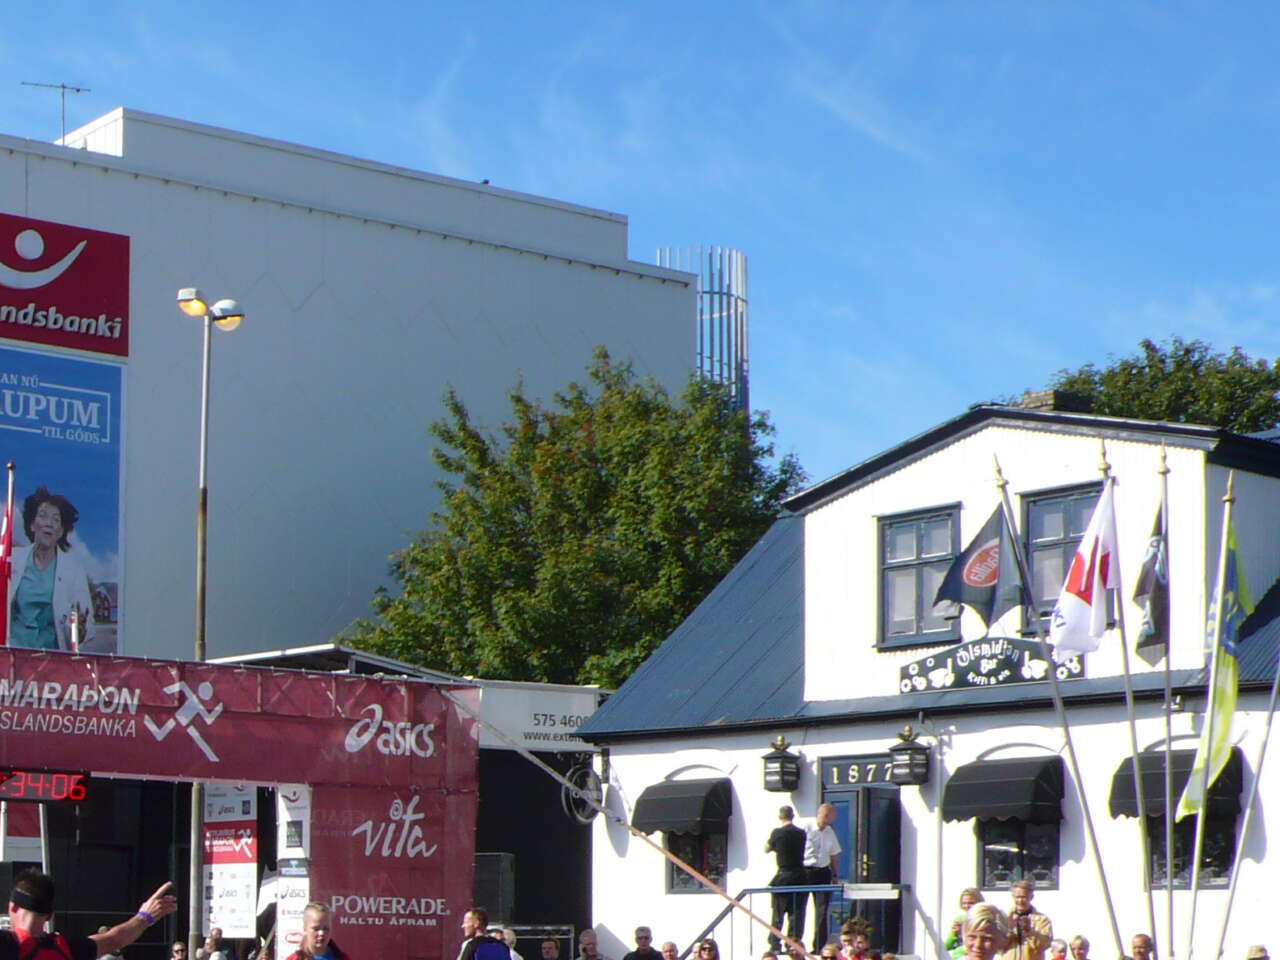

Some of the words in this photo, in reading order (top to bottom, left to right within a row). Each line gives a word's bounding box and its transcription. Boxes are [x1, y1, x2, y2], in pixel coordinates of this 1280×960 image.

[21, 374, 39, 389] NÚ
[41, 425, 65, 440] TIL
[533, 713, 557, 727] 575
[831, 764, 893, 785] 1877
[351, 796, 438, 858] vita
[331, 895, 446, 915] POWERADE
[340, 916, 384, 926] HALTU
[389, 914, 438, 927] ÁFRAM
